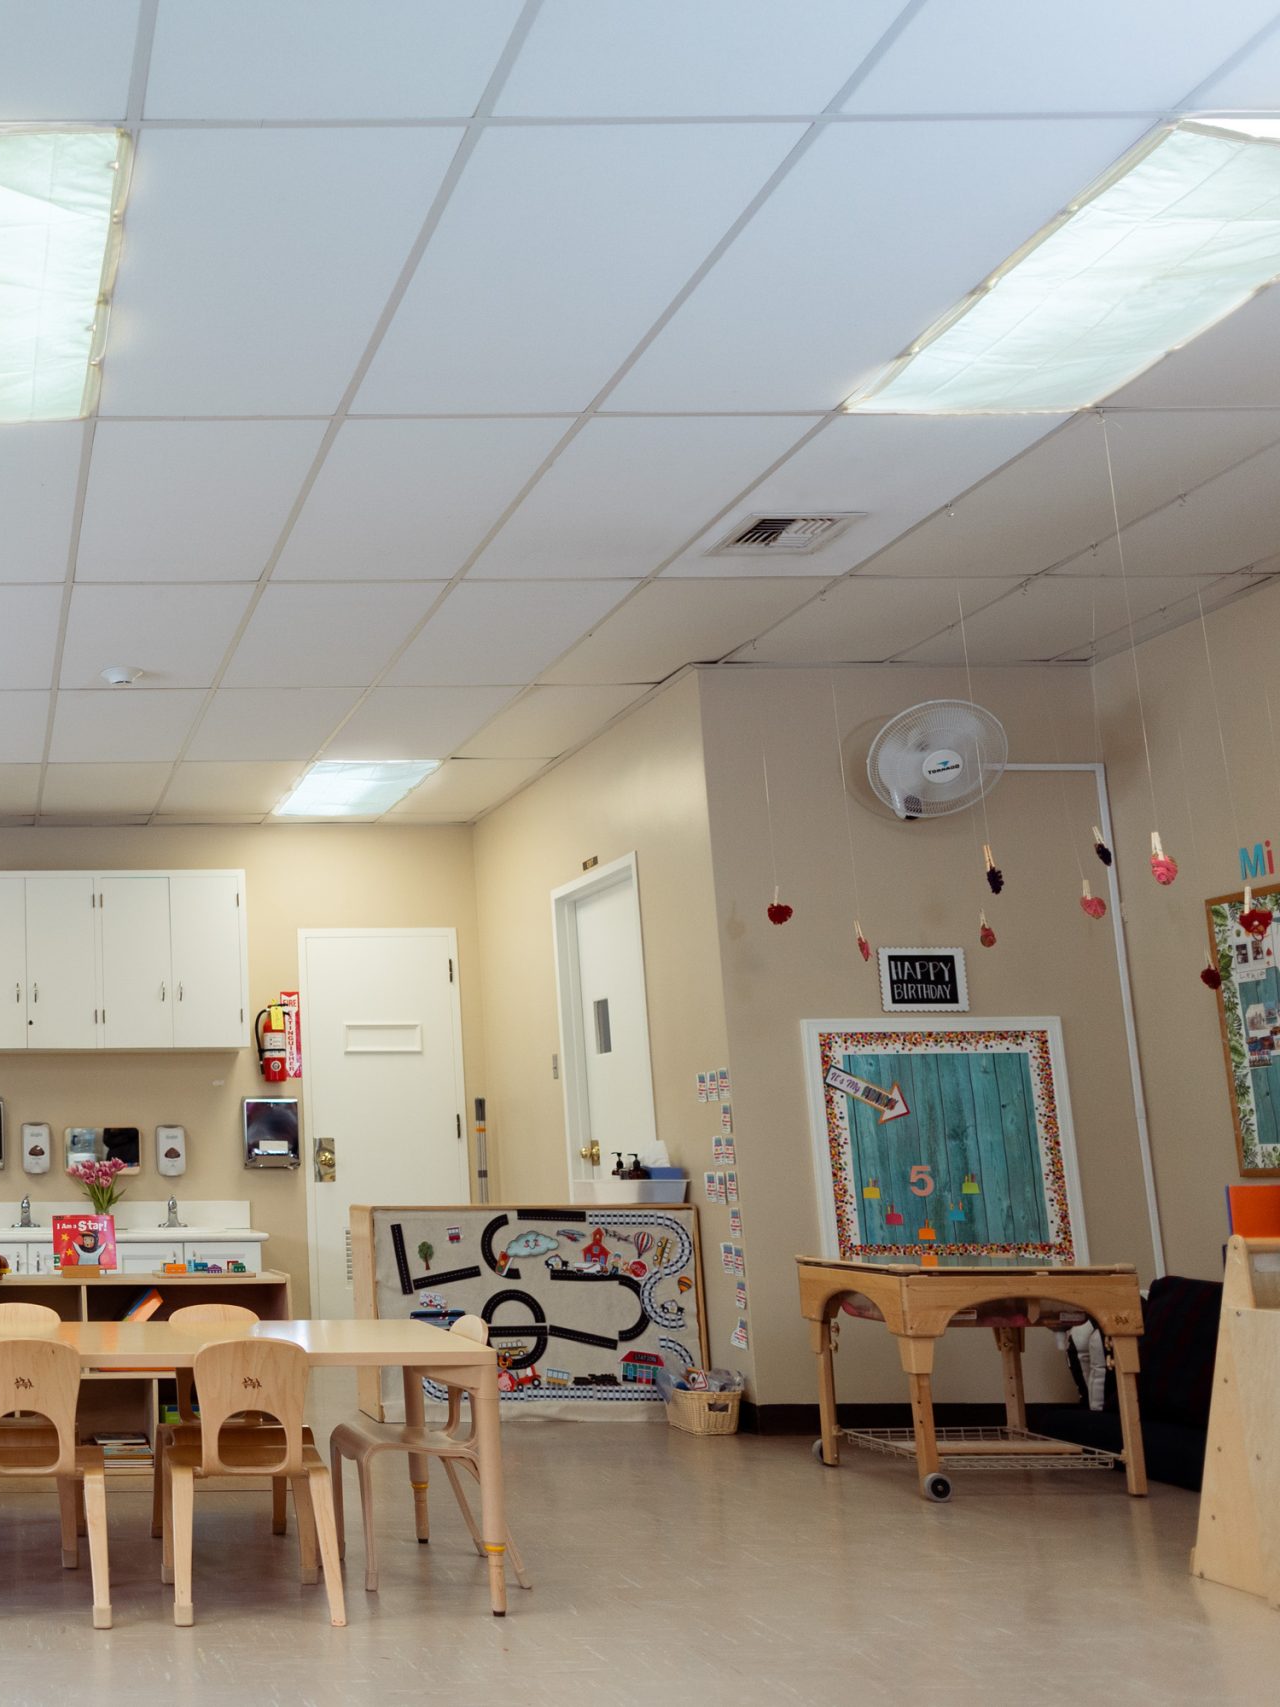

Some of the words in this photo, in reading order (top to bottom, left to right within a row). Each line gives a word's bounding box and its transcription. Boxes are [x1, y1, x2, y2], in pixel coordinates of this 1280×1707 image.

[1239, 839, 1275, 881] Mi
[890, 960, 951, 981] HAPPY
[894, 983, 951, 1000] BIRTHDAY
[909, 1165, 934, 1197] 5
[78, 1220, 107, 1232] Star!
